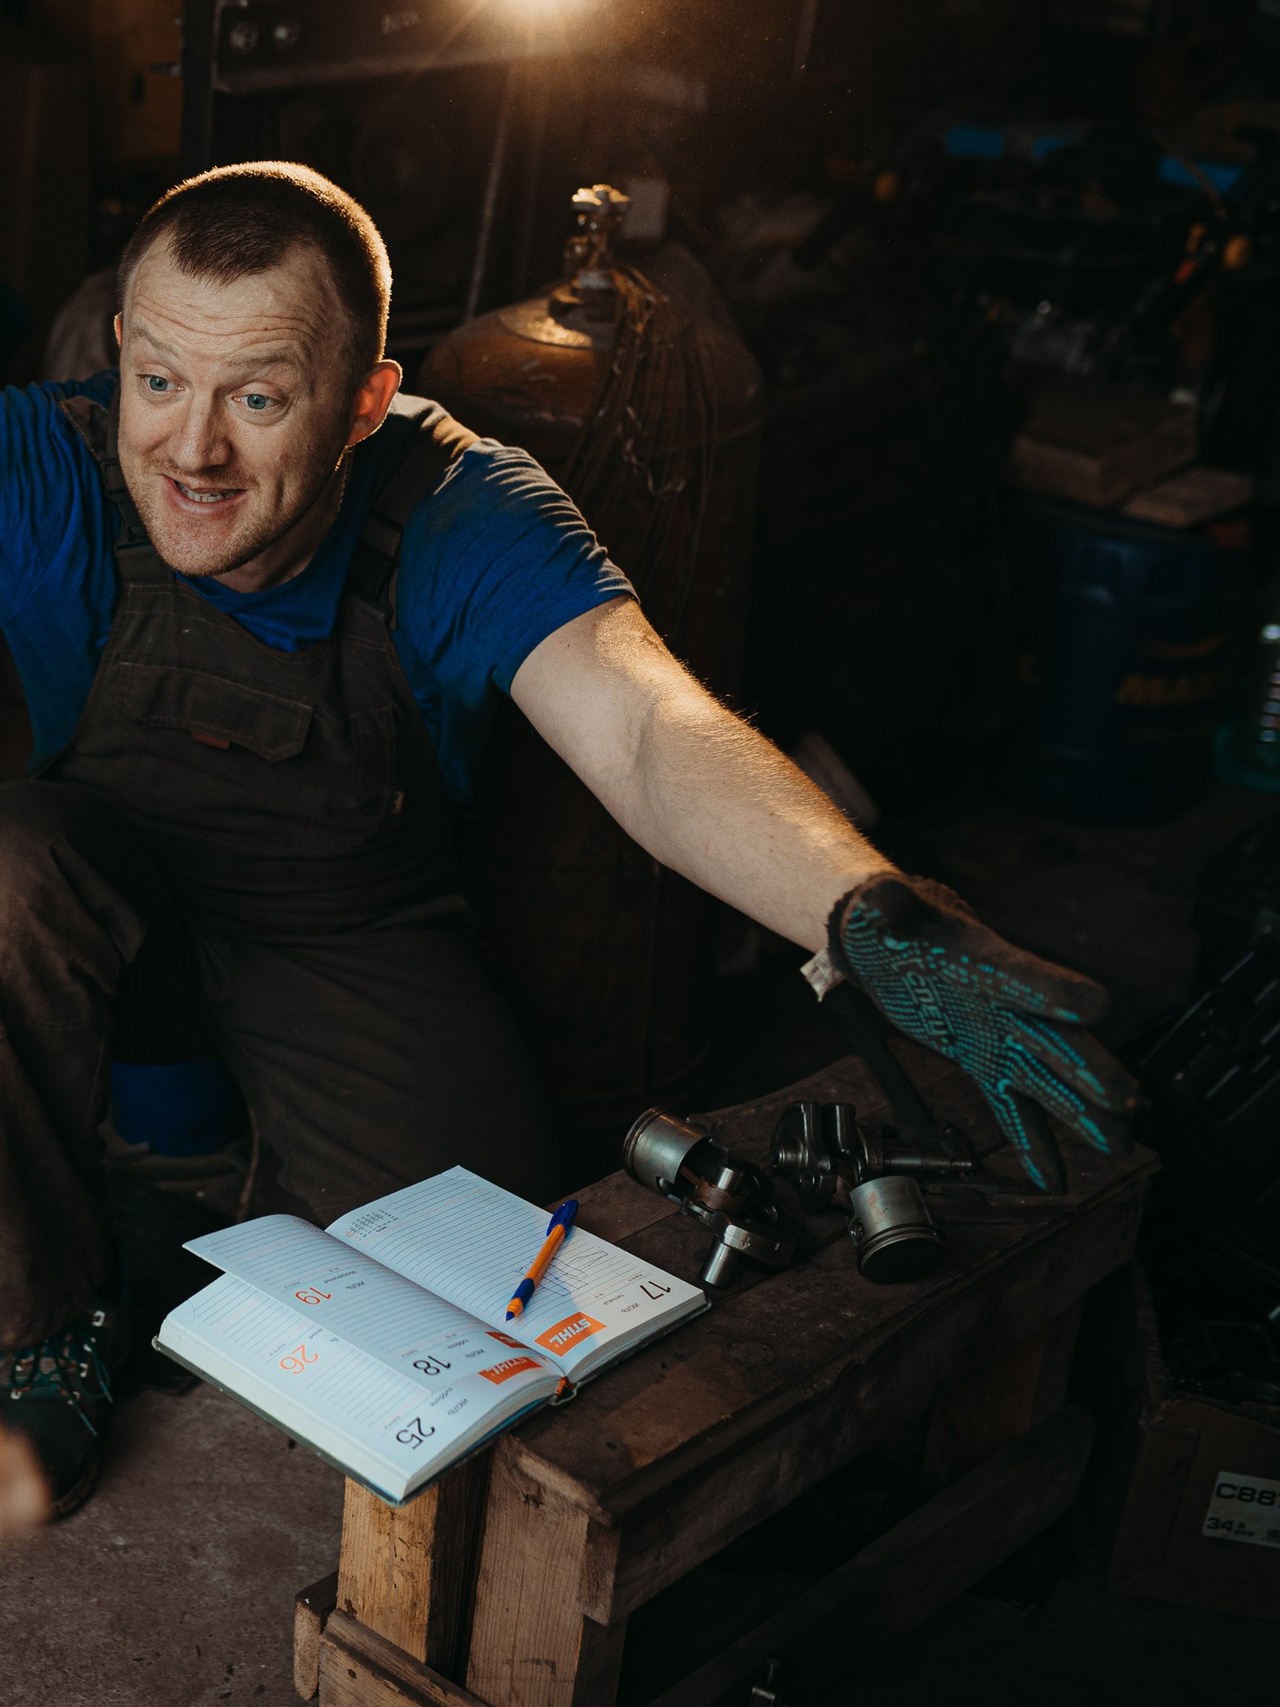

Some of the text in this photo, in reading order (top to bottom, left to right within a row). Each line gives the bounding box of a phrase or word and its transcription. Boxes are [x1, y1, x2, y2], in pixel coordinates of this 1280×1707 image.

[295, 1287, 331, 1305] 19
[640, 1280, 671, 1300] 17
[549, 1318, 592, 1345] STIHL
[280, 1344, 319, 1375] 26
[413, 1355, 451, 1376] 18
[396, 1417, 435, 1450] 25
[1216, 1483, 1280, 1508] C88
[1206, 1517, 1234, 1532] 34
